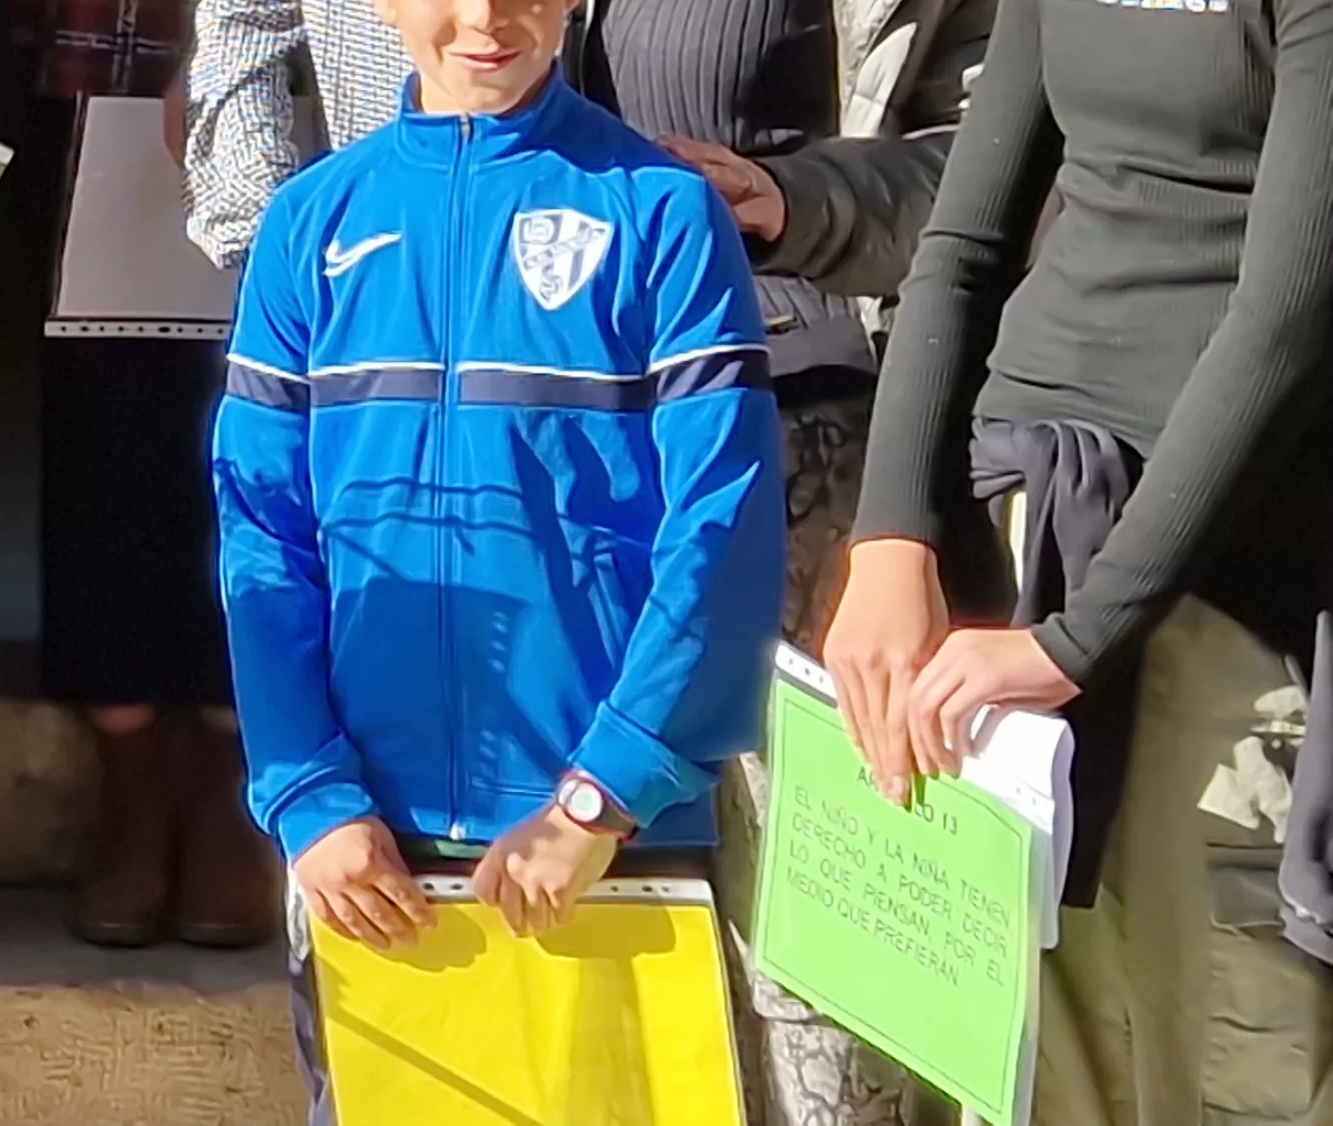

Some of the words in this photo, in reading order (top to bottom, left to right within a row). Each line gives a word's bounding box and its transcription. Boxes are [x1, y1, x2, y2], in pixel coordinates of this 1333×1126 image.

[794, 785, 813, 811] EL
[867, 827, 878, 845] Y
[885, 838, 904, 864] LA
[942, 812, 958, 835] 13
[786, 866, 834, 908] MEDIO
[837, 897, 869, 932] QUE
[790, 839, 809, 864] LO
[820, 858, 852, 891] QUE
[944, 931, 975, 967] POR
[986, 960, 1005, 986] EL
[792, 812, 865, 869] DERECHO
[877, 863, 887, 883] A
[899, 874, 954, 920] PODER
[963, 913, 1007, 958] DECIR
